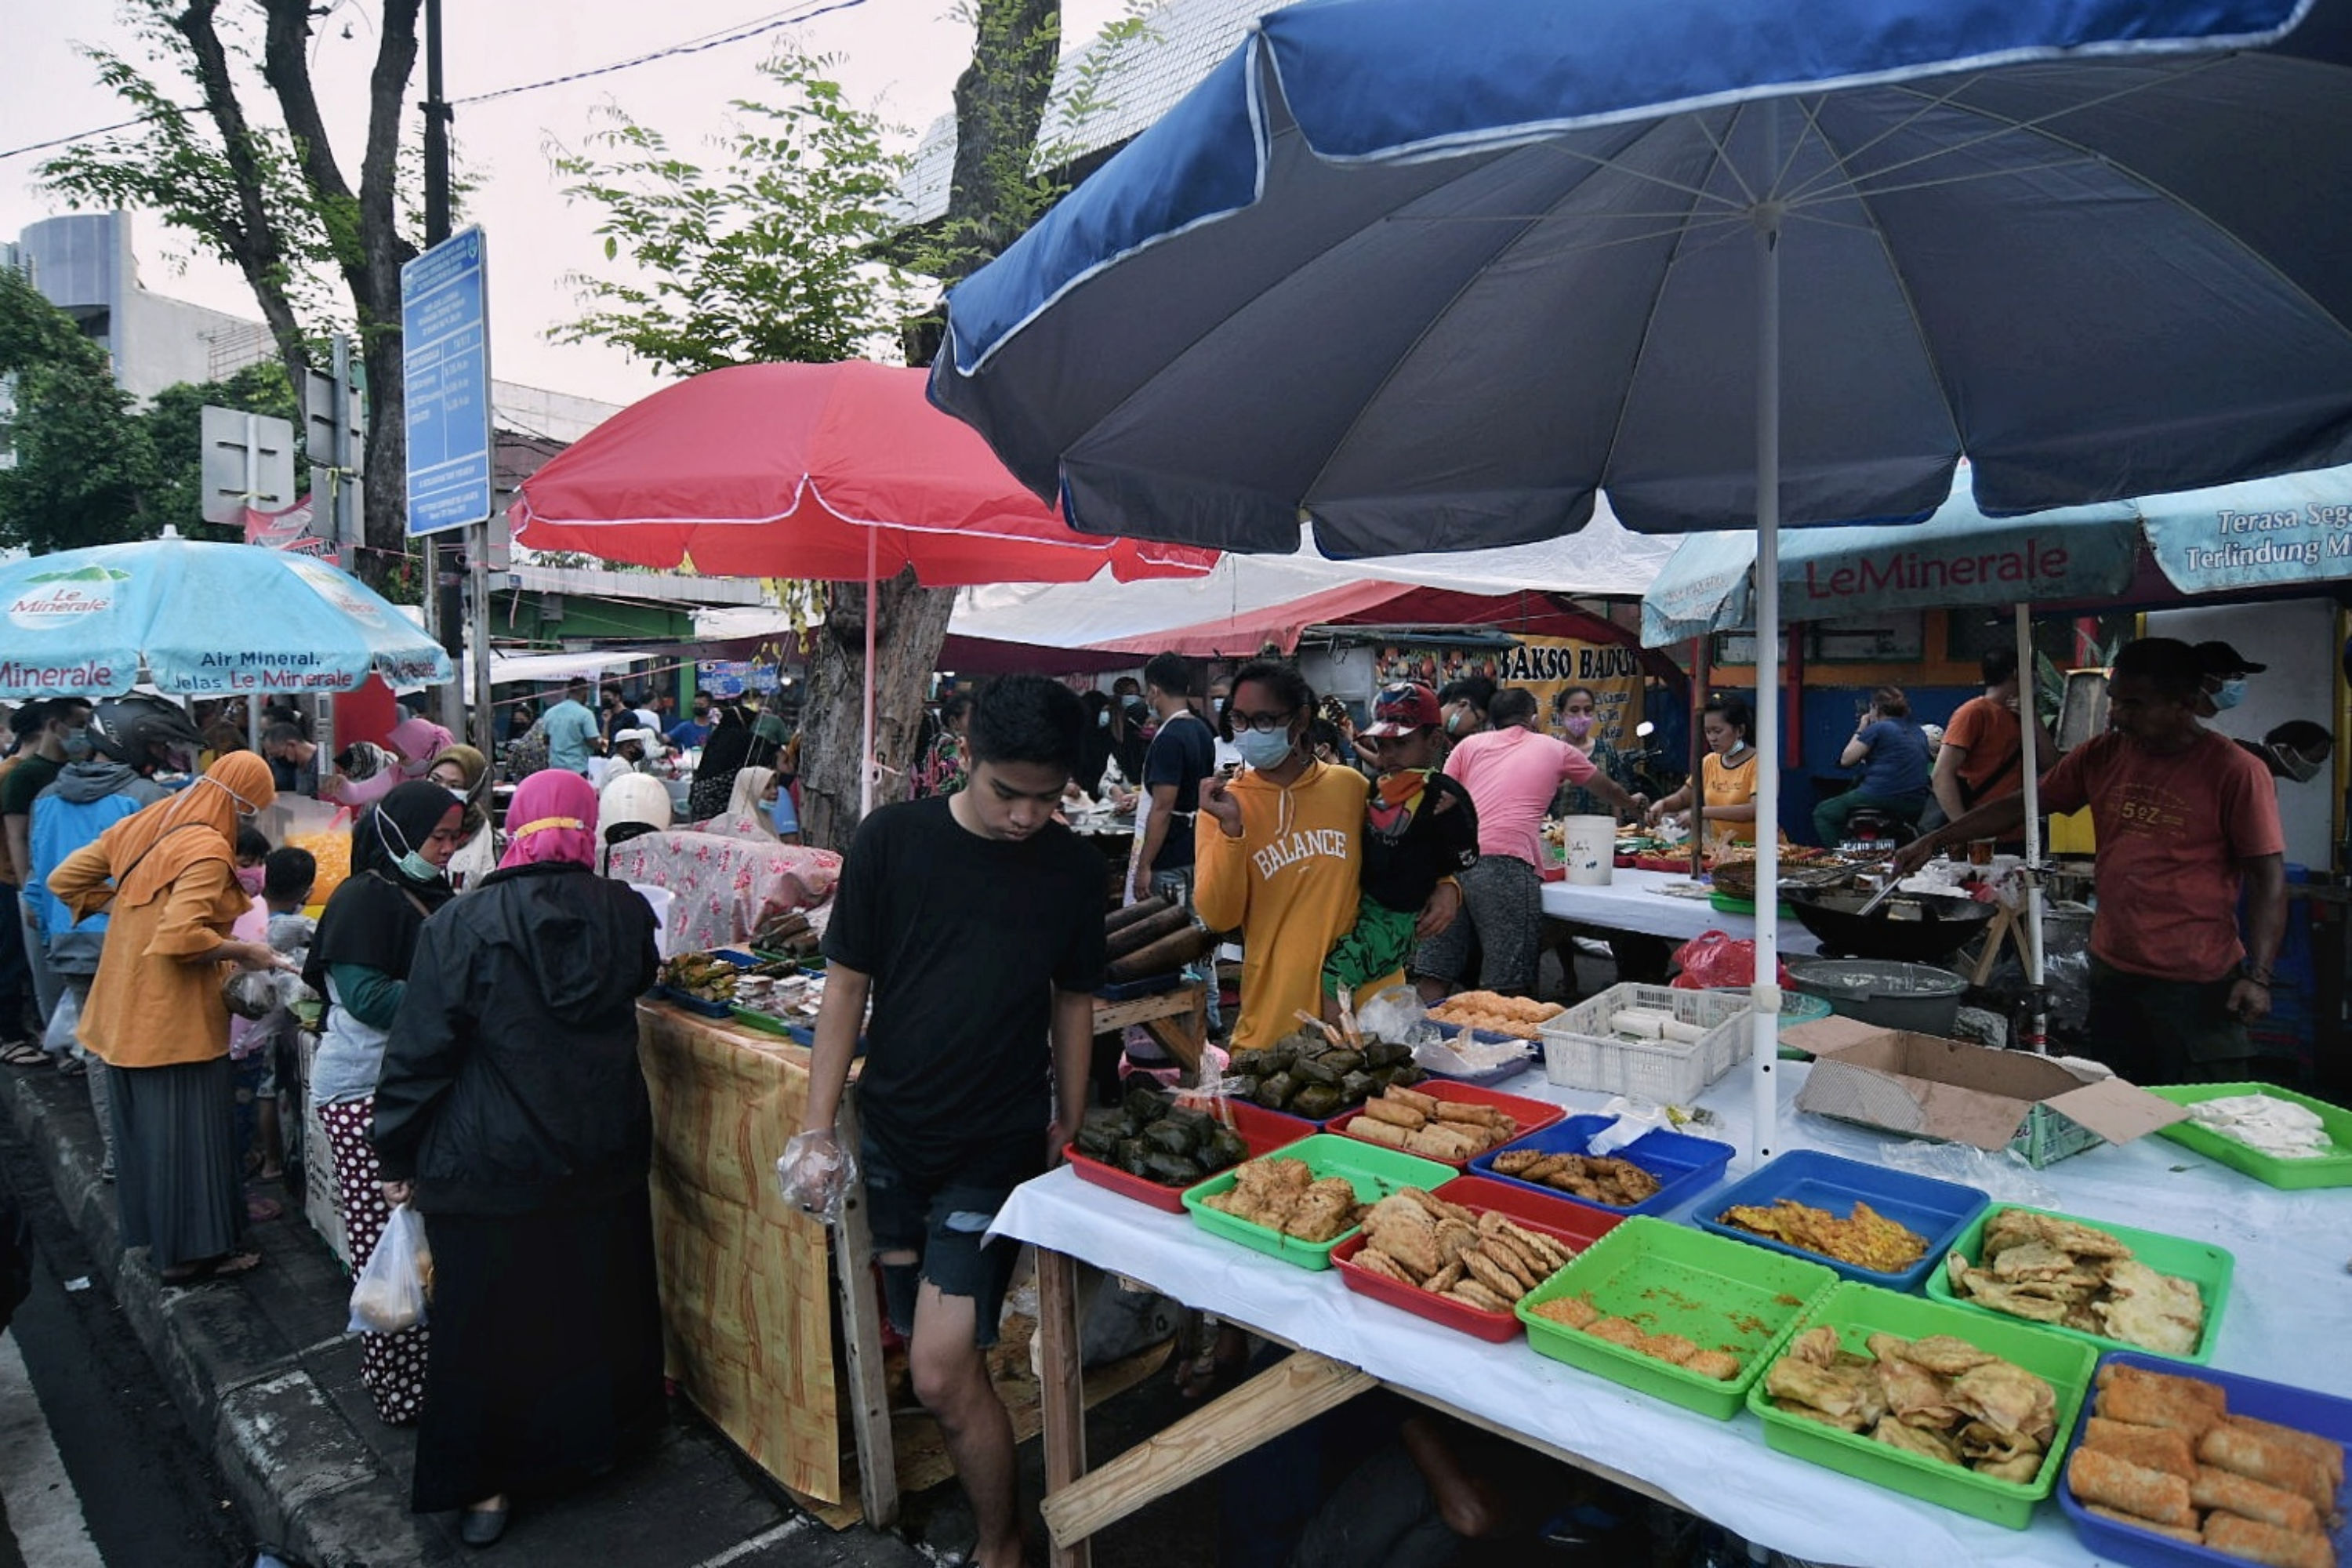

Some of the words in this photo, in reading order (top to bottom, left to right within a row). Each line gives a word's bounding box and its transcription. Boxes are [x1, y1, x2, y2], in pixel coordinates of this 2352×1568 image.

[2218, 510, 2299, 535] Terasa
[2186, 538, 2321, 572] Terlindung
[53, 589, 82, 601] Le
[9, 599, 108, 612] Minerale
[201, 652, 232, 666] Air
[174, 673, 222, 689] Jelas
[230, 670, 254, 688] Le
[263, 669, 352, 687] Minerale
[1253, 829, 1346, 880] BALANCE
